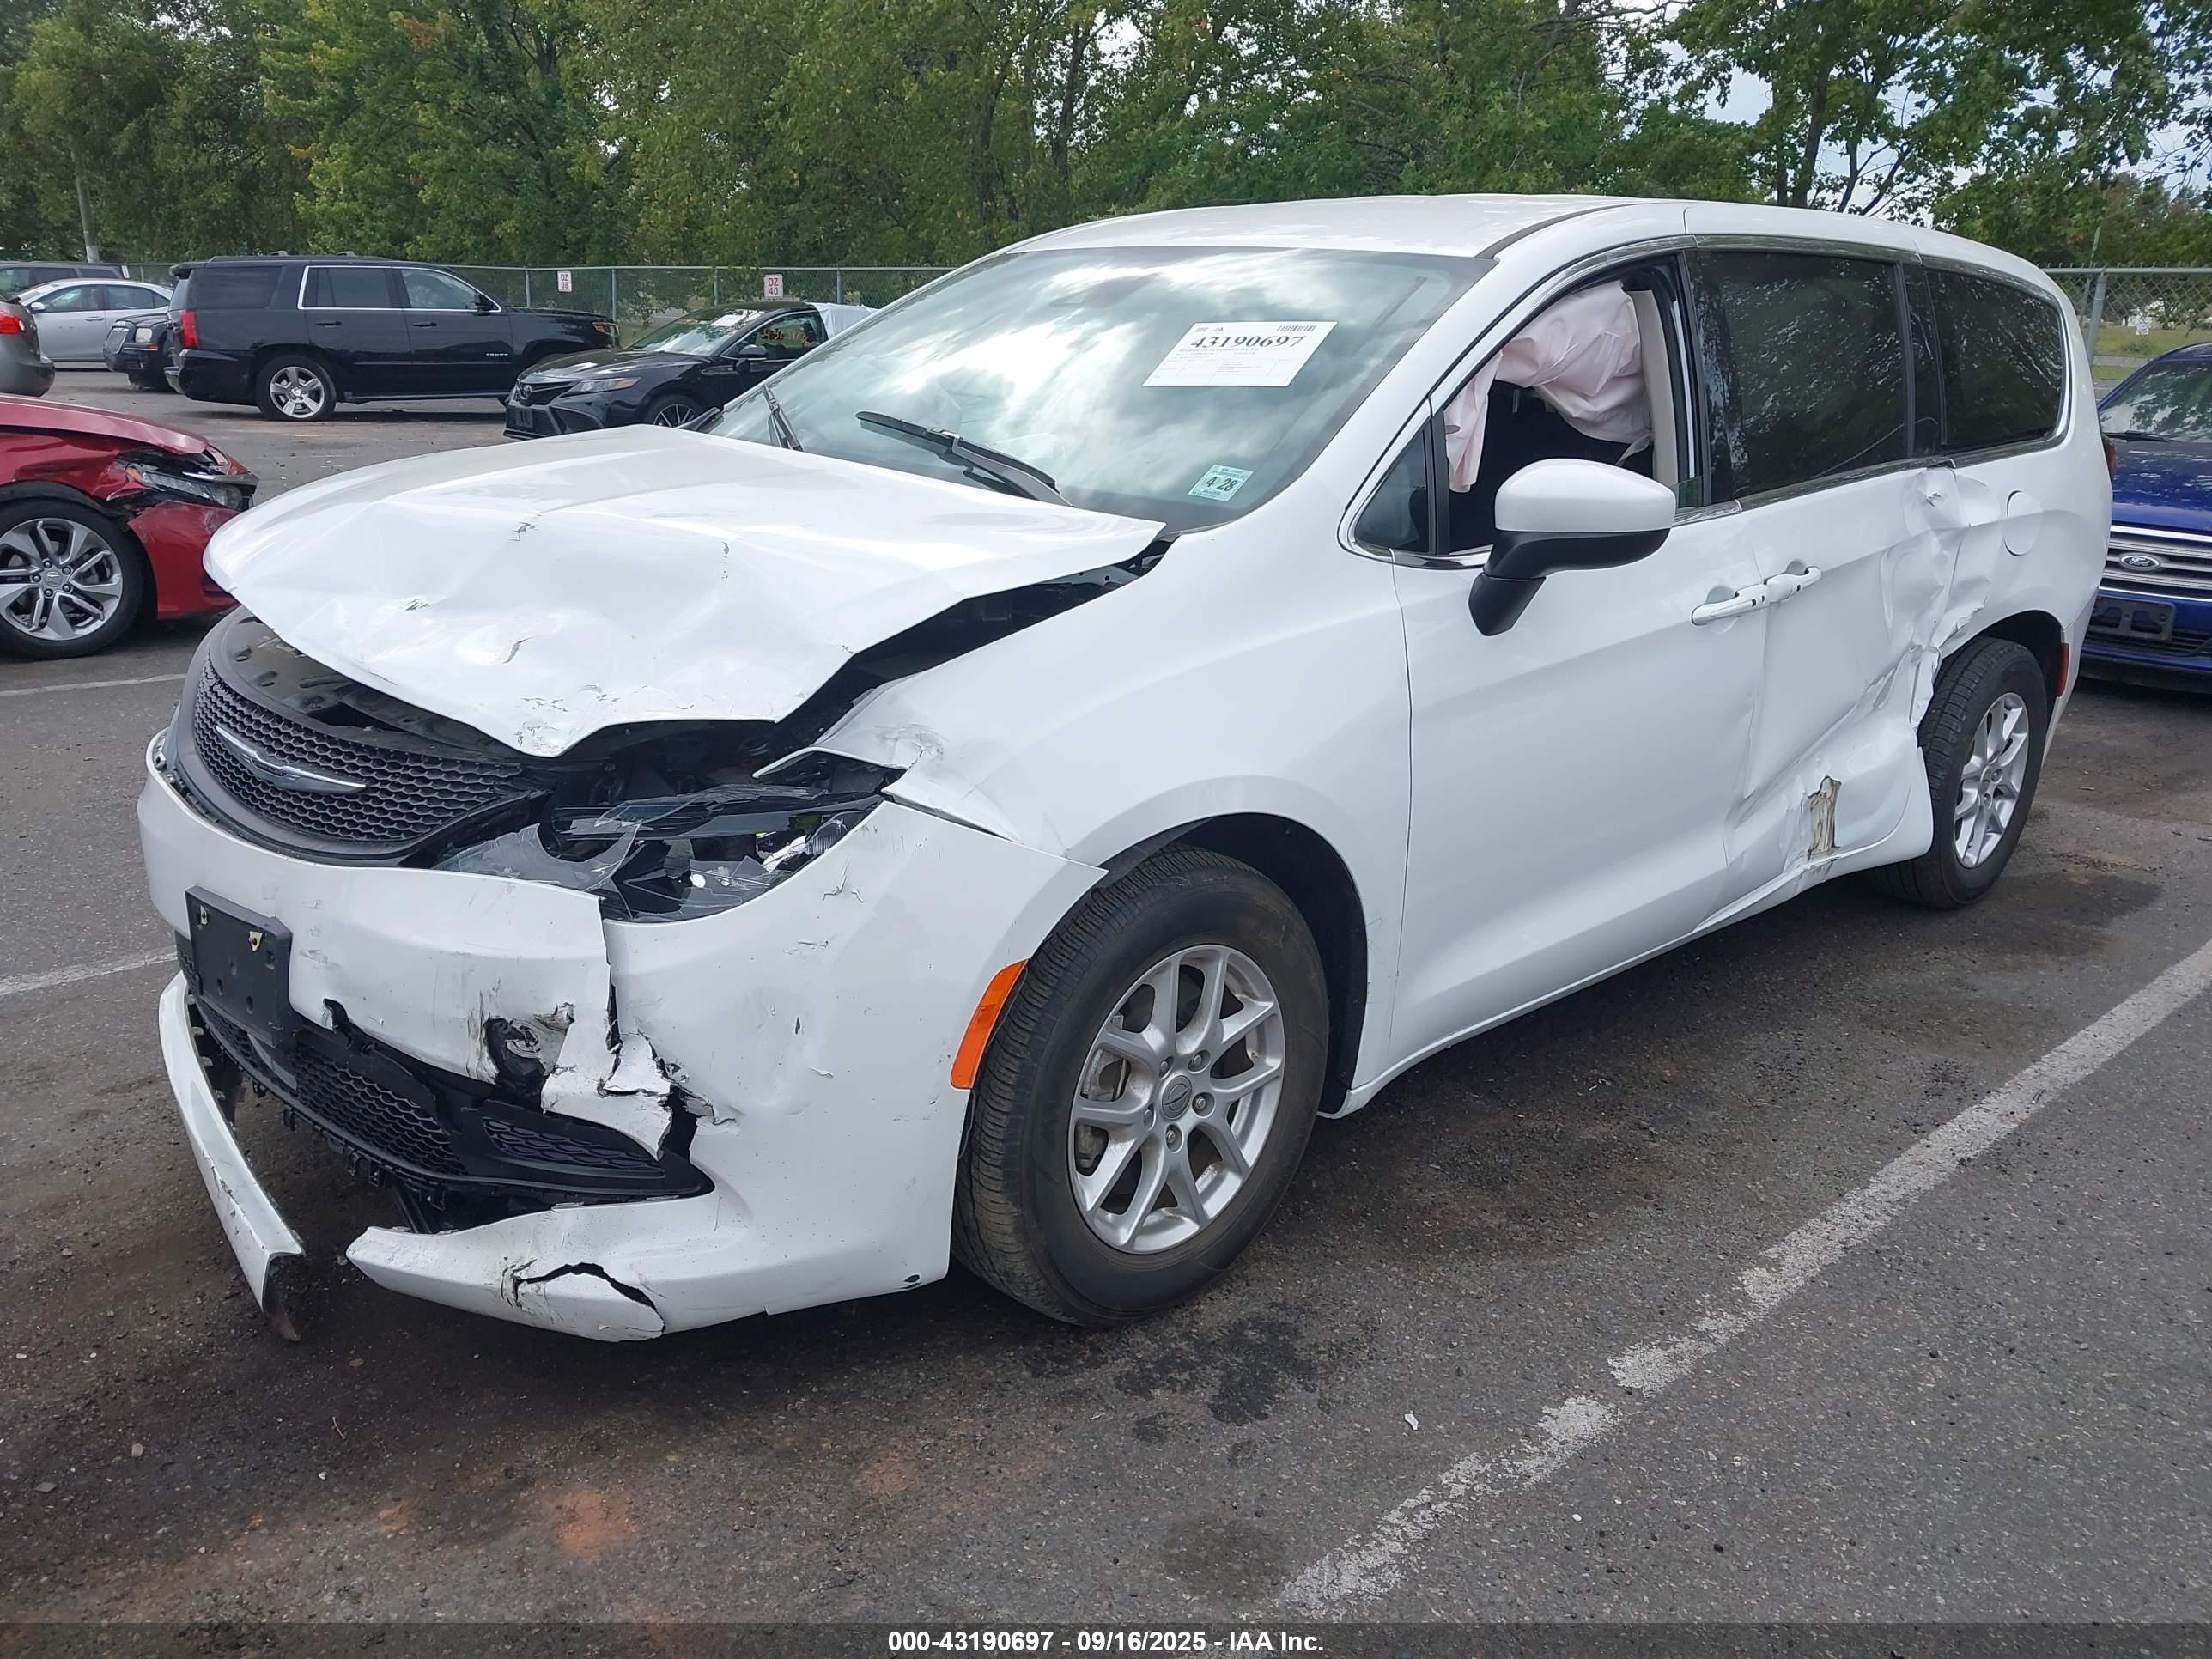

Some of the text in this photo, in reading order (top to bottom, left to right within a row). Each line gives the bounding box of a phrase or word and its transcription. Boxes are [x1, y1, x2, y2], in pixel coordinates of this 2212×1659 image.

[769, 277, 779, 287] DZ
[769, 287, 779, 295] 40
[1190, 335, 1306, 349] 43190697
[1206, 476, 1218, 488] 4
